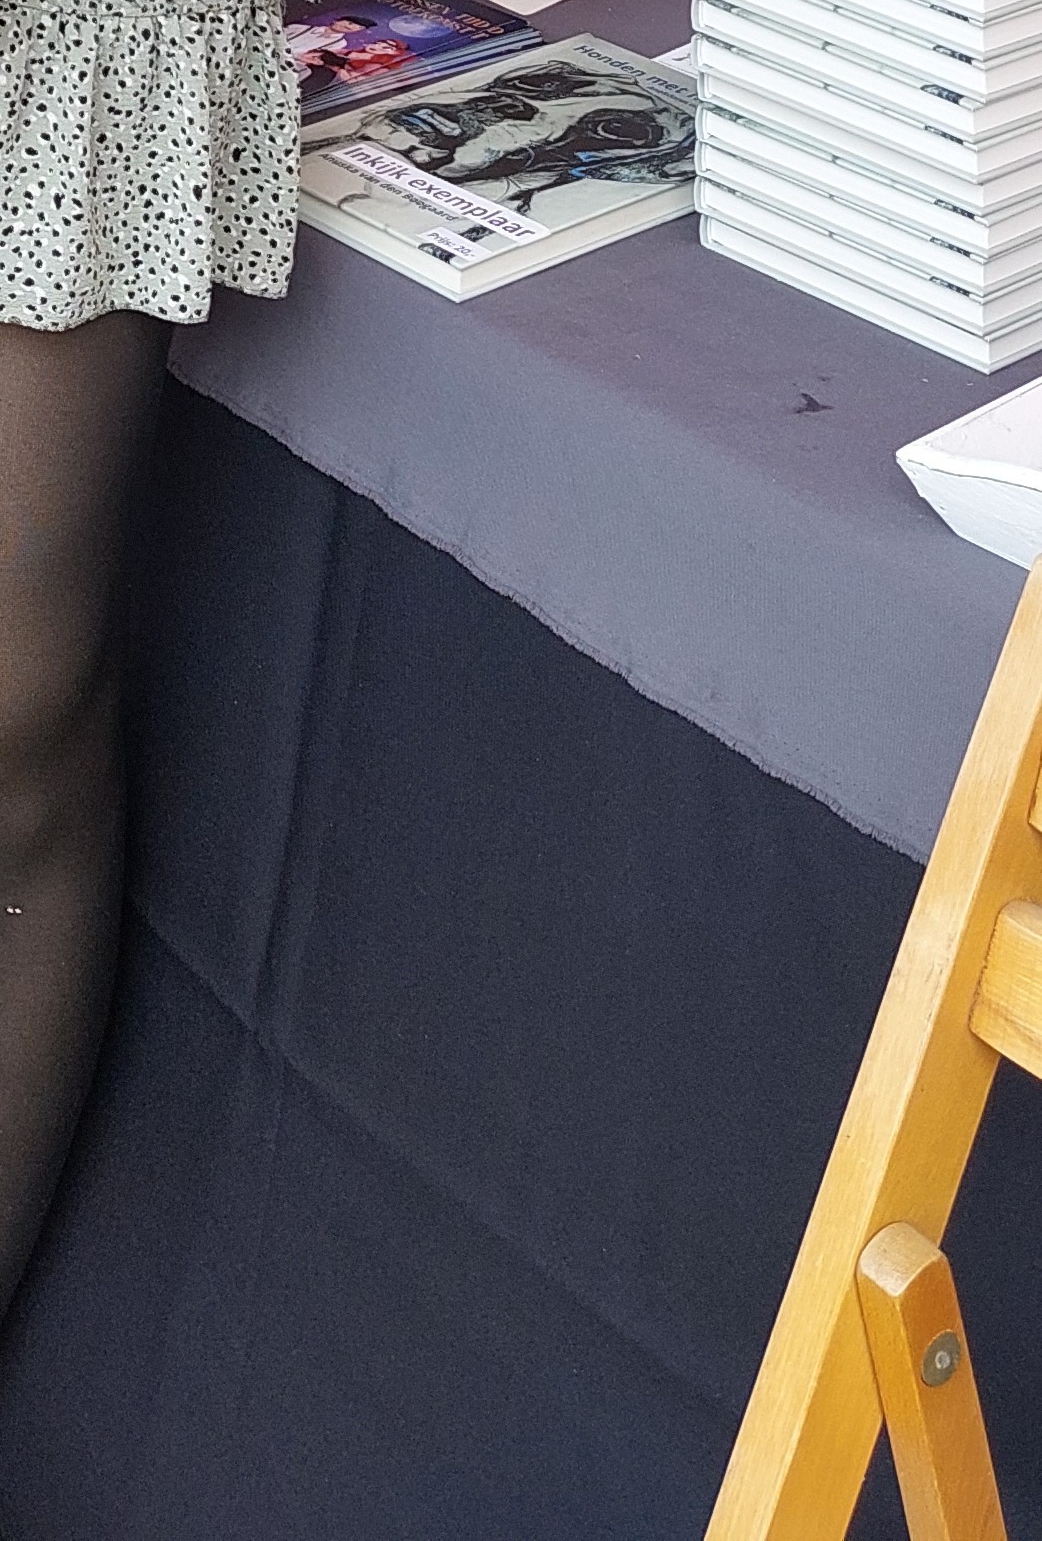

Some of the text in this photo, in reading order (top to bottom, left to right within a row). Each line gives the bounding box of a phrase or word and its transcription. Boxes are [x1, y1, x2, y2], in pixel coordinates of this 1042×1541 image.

[572, 44, 689, 94] Honden met
[317, 152, 360, 176] Anuska
[358, 172, 381, 188] van
[378, 182, 403, 197] den
[342, 146, 537, 240] Inkijk exemplaar
